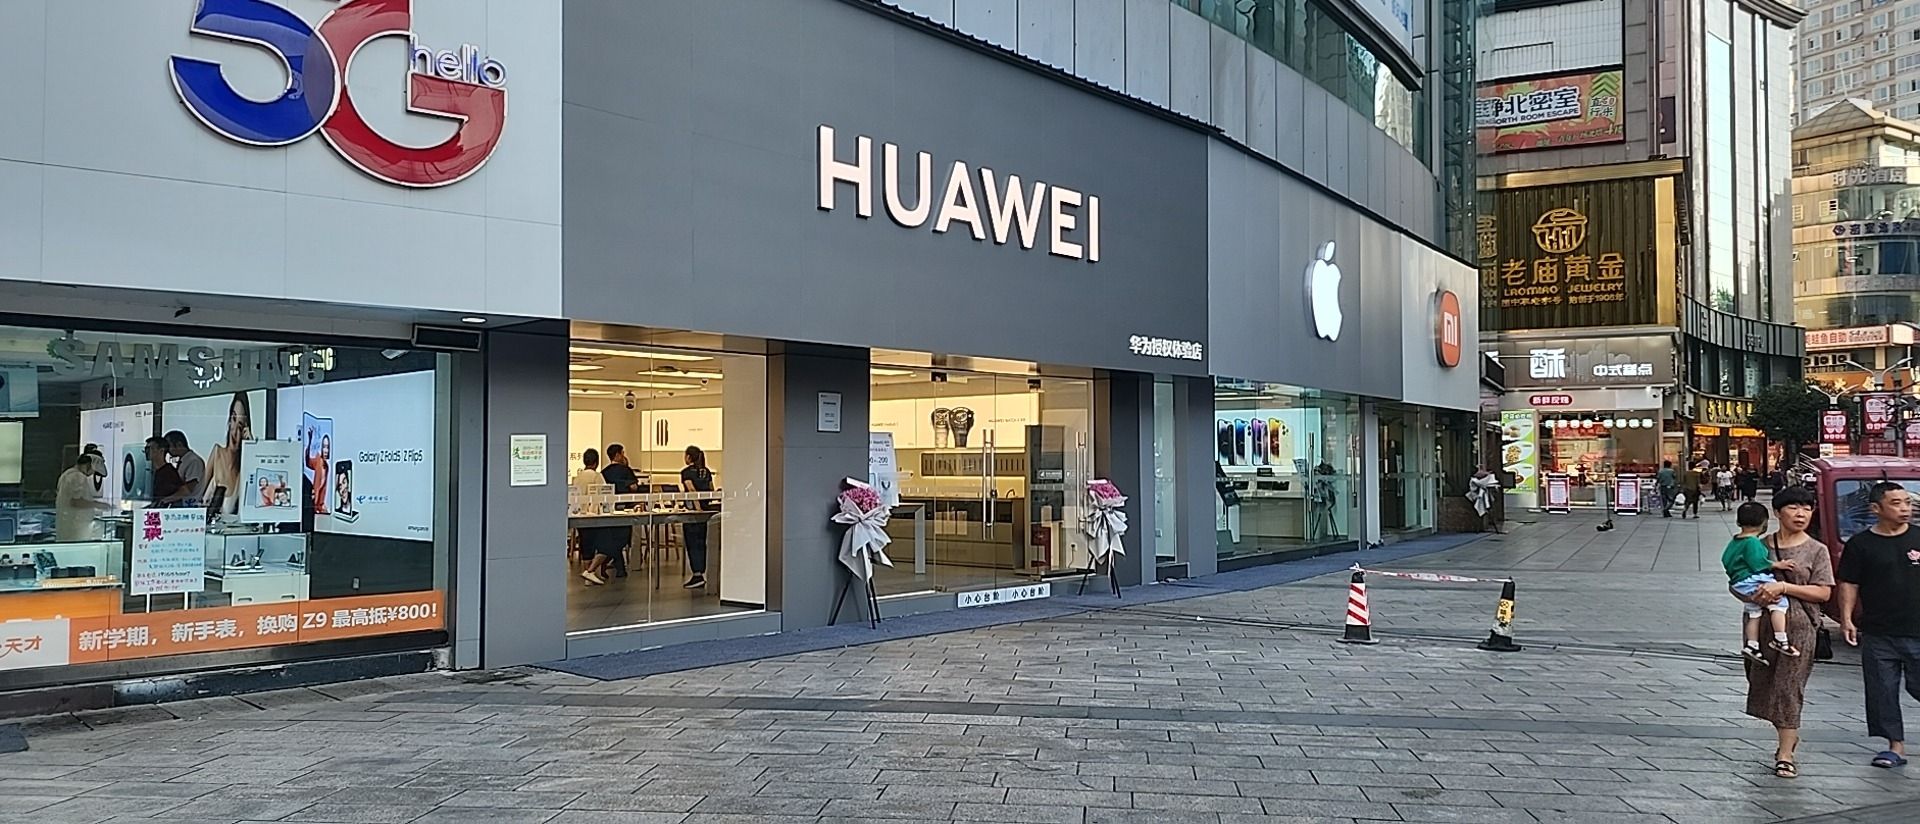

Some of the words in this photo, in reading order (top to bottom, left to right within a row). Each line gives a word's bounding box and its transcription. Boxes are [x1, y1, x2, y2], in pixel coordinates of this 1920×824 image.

[409, 32, 506, 88] hello
[1520, 111, 1546, 122] ROOM
[1547, 107, 1580, 118] ESCAPE
[816, 124, 1100, 262] HUAWEI
[1501, 252, 1625, 287] 老庙黄金
[1567, 281, 1624, 294] JEWELRY
[50, 336, 326, 384] SAMSUNG
[1128, 334, 1203, 361] 华为授权体验店
[1529, 348, 1567, 379] 酥
[359, 451, 380, 465] Galaxy
[302, 611, 328, 630] Z9
